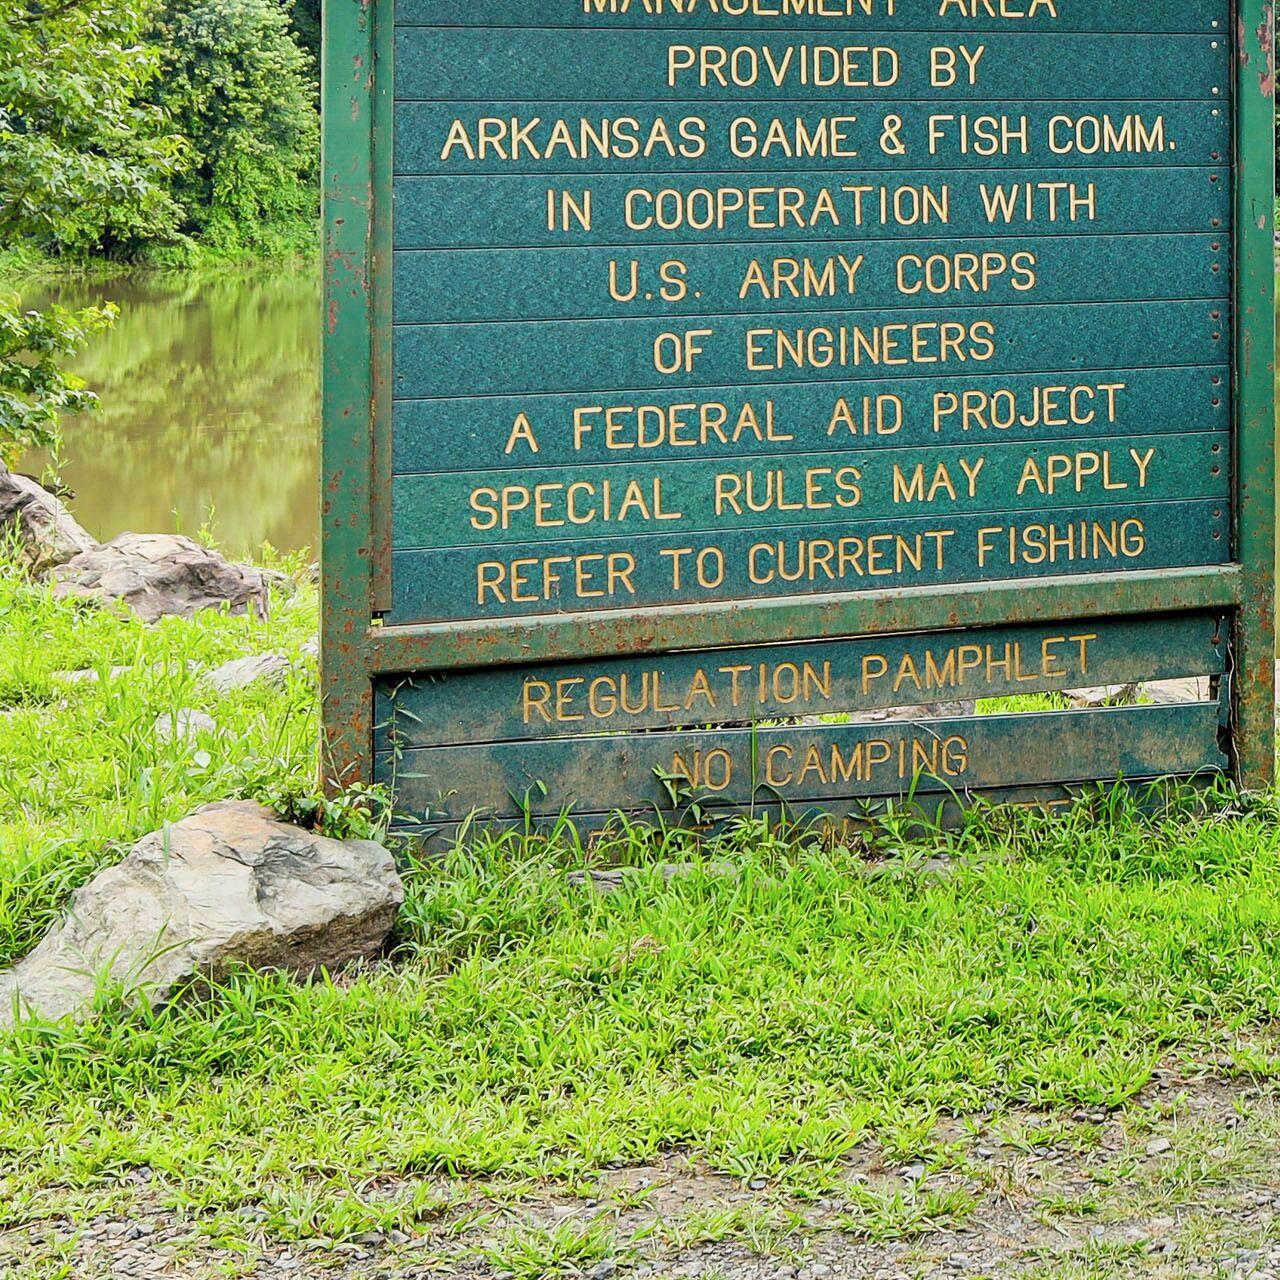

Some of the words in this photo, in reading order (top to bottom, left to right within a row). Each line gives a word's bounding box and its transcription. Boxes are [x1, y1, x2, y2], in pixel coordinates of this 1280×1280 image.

[667, 45, 900, 87] PROVIDED
[930, 45, 986, 88] BY
[440, 116, 707, 162] ARKANSAS
[729, 116, 858, 158] GAME
[879, 115, 906, 155] &
[928, 114, 1028, 156] FISH
[1048, 114, 1178, 155] COMM.
[546, 188, 593, 232] IN
[624, 185, 950, 230] COOPERATION
[980, 182, 1096, 223] WITH
[608, 259, 703, 302] U.S.
[738, 256, 864, 299] ARMY
[895, 251, 1037, 294] CORPS
[652, 329, 713, 374] OF
[745, 320, 996, 372] ENGINEERS
[504, 412, 540, 454] A
[572, 400, 795, 450] FEDERAL
[826, 394, 904, 436] AID
[932, 383, 1127, 433] PROJECT
[469, 477, 684, 531] SPECIAL
[714, 466, 864, 515] RULES
[892, 457, 986, 503] MAY
[1016, 448, 1156, 495] APPLY
[476, 552, 638, 605] REFER
[659, 546, 726, 589] TO
[748, 529, 956, 586] CURRENT
[976, 518, 1146, 566] FISHING
[523, 660, 831, 723] REGULATION
[860, 633, 1099, 697] PAMPHLET
[672, 747, 733, 792] NO
[765, 735, 969, 787] CAMPING
